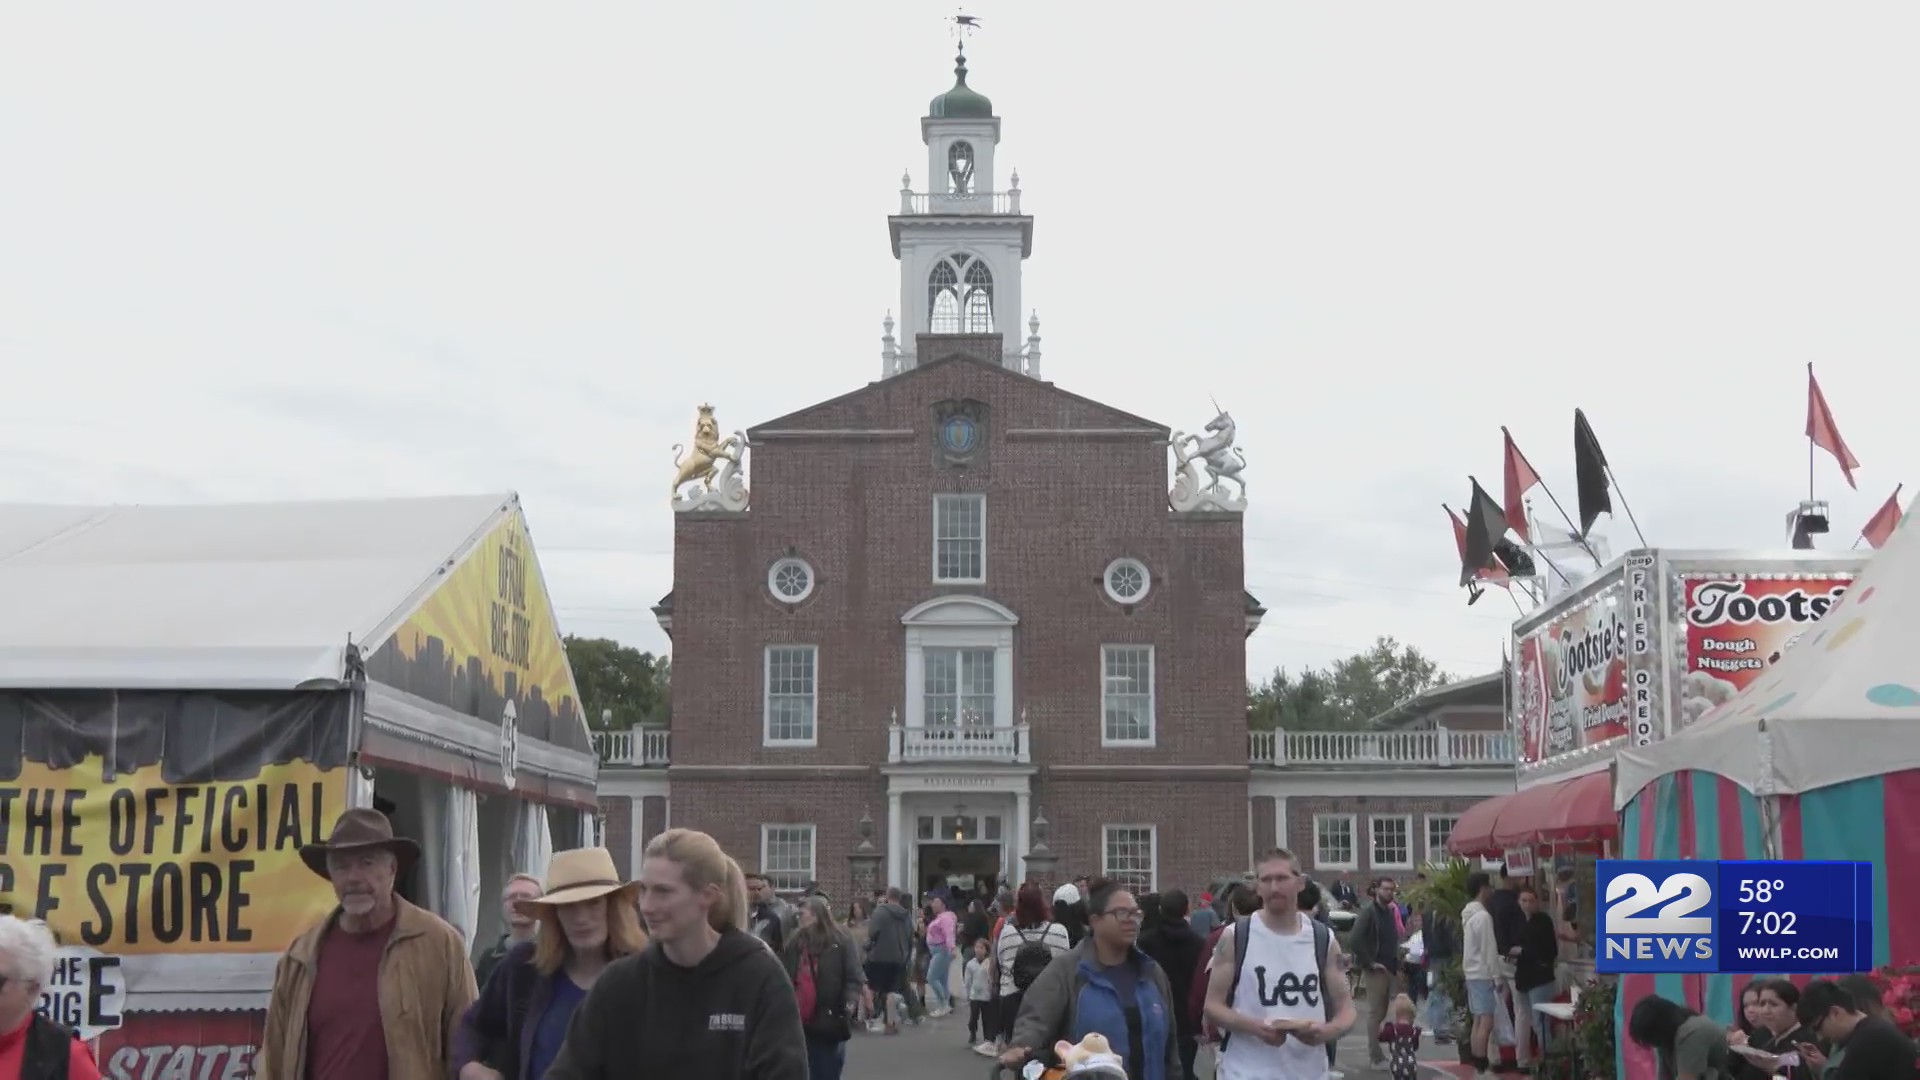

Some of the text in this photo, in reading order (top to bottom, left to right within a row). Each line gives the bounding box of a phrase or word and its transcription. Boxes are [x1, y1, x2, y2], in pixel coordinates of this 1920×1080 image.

[1634, 573, 1646, 651] FRIED
[1691, 583, 1845, 624] Toots
[1558, 612, 1625, 690] Tootsie's
[1698, 657, 1763, 671] Nuggets
[1703, 638, 1756, 652] Dough
[0, 782, 327, 856] THE OFFICIAL
[81, 860, 255, 945] STORE
[50, 957, 83, 986] HE
[88, 957, 120, 1026] E
[1254, 965, 1318, 1007] Lee
[107, 1045, 257, 1080] STATE
